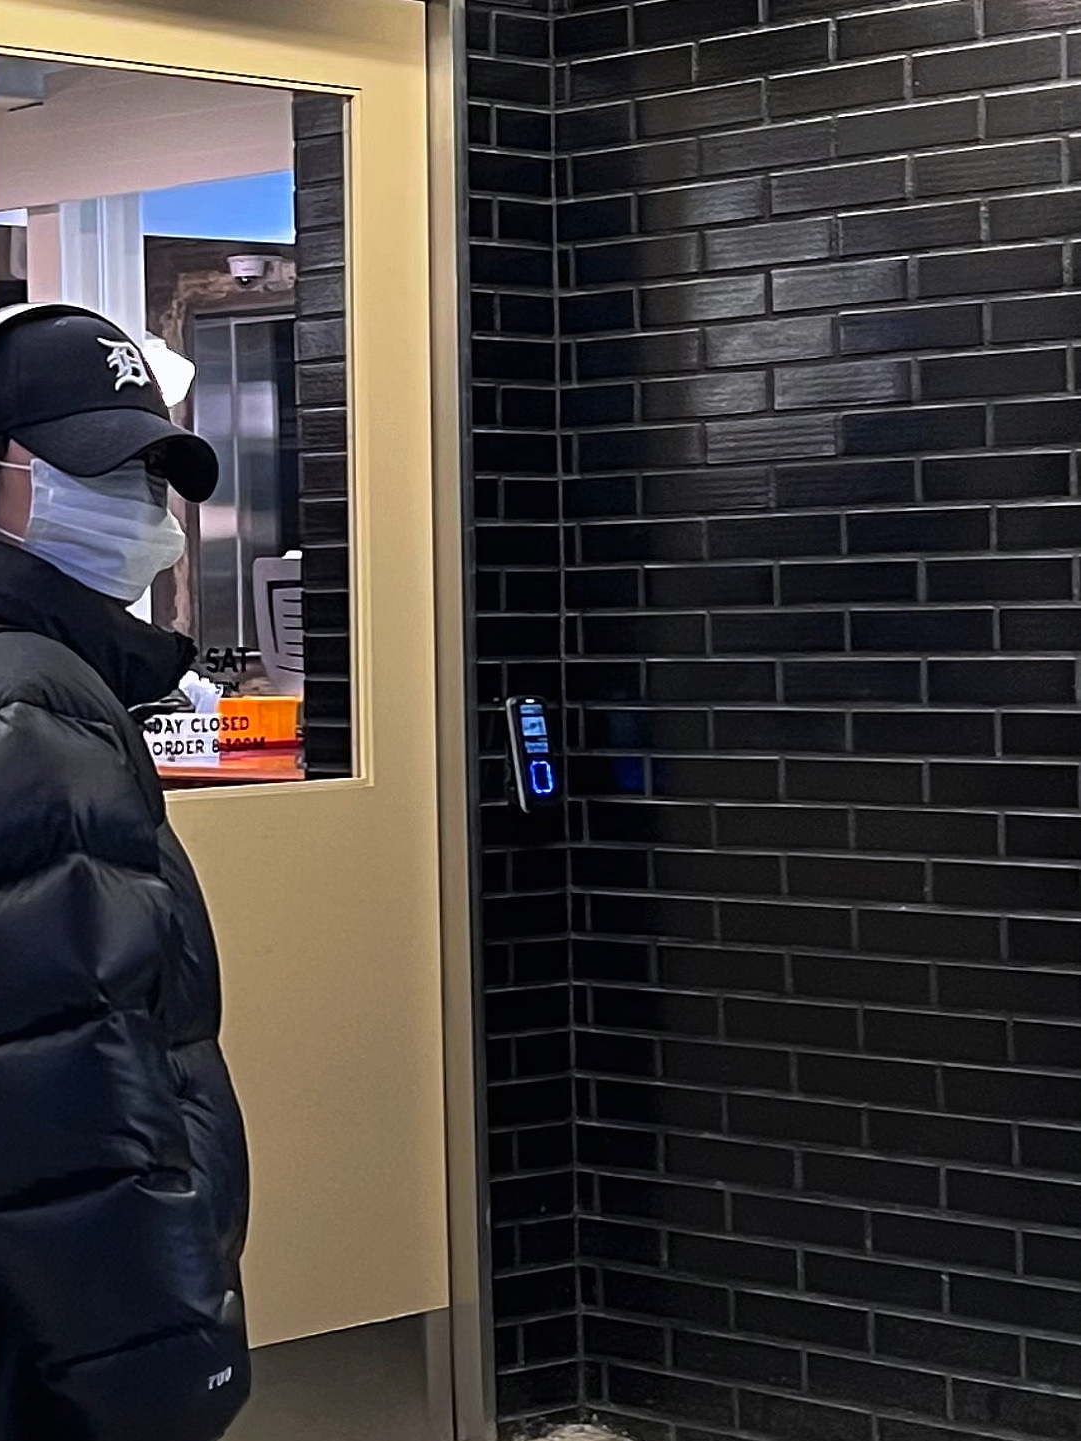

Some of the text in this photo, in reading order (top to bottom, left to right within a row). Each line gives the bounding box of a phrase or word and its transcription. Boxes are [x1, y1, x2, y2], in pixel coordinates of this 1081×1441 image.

[206, 647, 251, 673] SAT
[191, 716, 249, 733] CLOSED
[153, 739, 205, 756] ORDER
